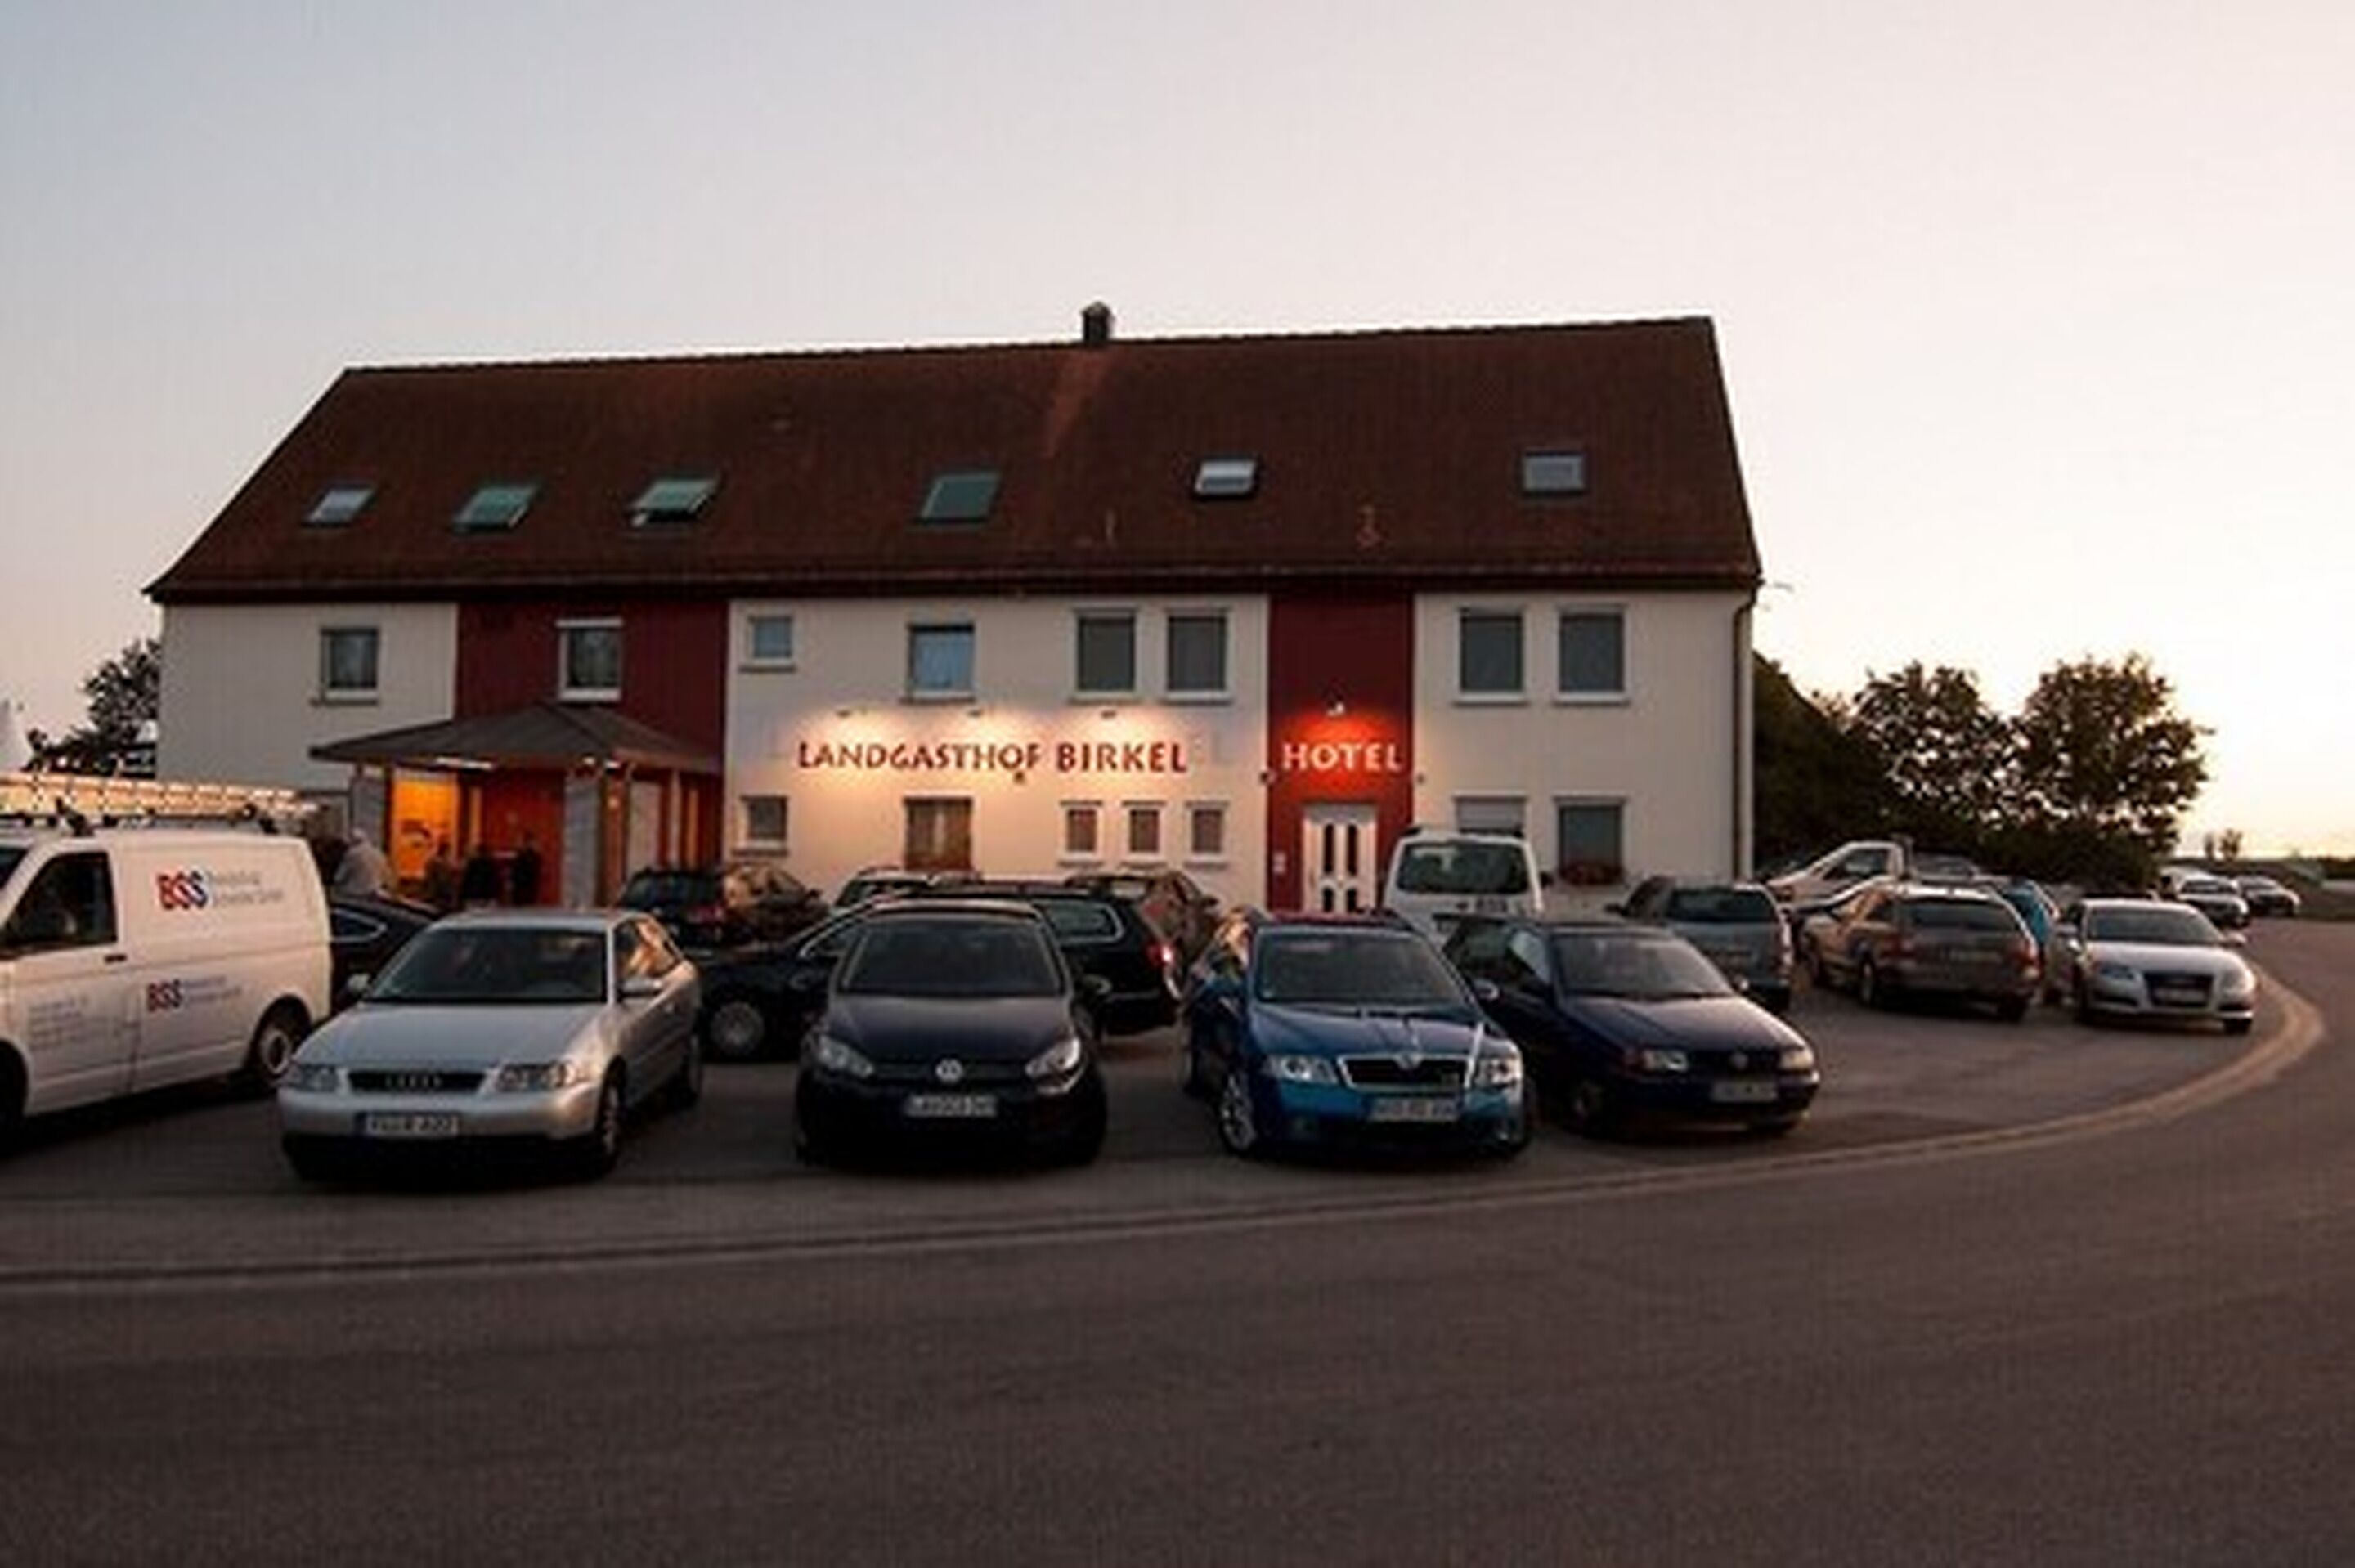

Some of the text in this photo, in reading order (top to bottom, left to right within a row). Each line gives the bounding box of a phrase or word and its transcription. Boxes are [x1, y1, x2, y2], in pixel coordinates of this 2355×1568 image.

[798, 741, 1187, 773] LANDGASTHOF BIRKEL
[1282, 741, 1402, 773] HOTEL
